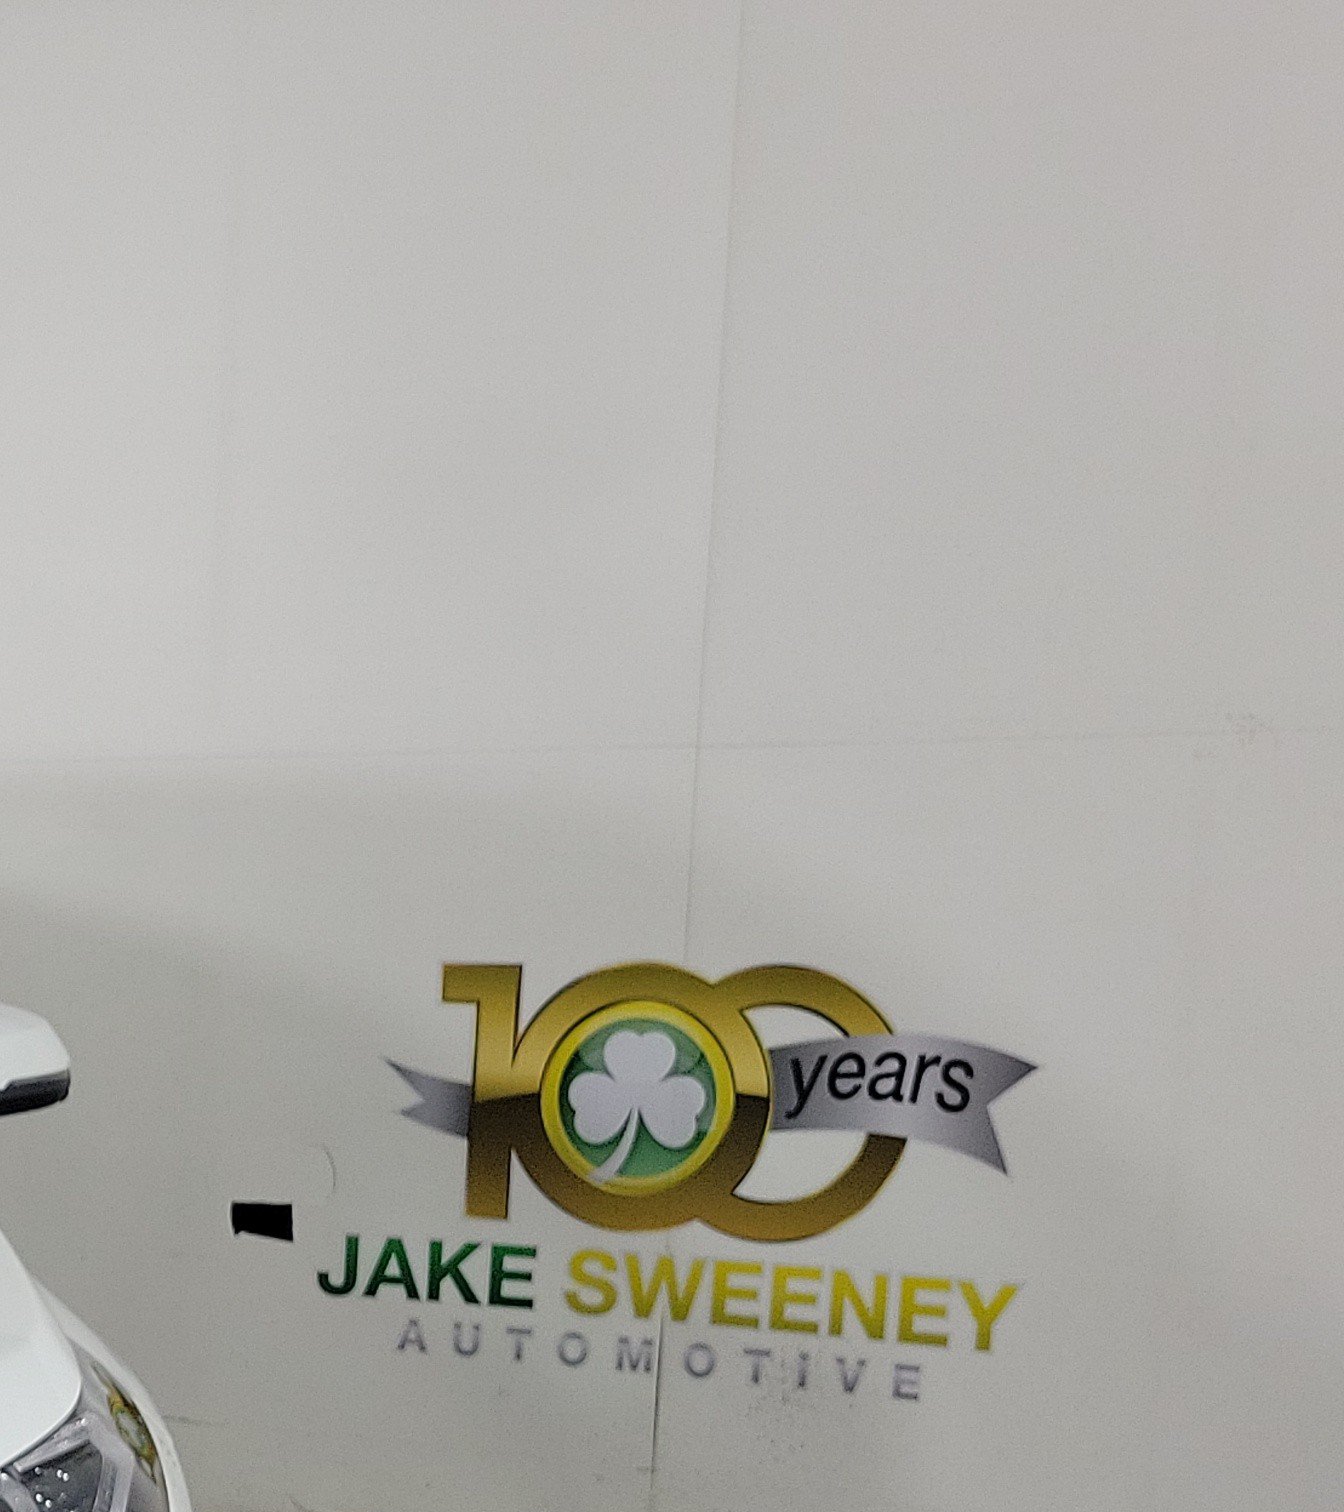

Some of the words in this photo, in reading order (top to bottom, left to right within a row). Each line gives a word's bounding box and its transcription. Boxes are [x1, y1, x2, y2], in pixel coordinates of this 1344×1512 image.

[441, 962, 907, 1242] 100
[784, 1049, 973, 1119] years
[317, 1234, 536, 1309] JAKE
[564, 1247, 1019, 1351] SWEENEY
[397, 1317, 920, 1400] AUTOMOTIVE
